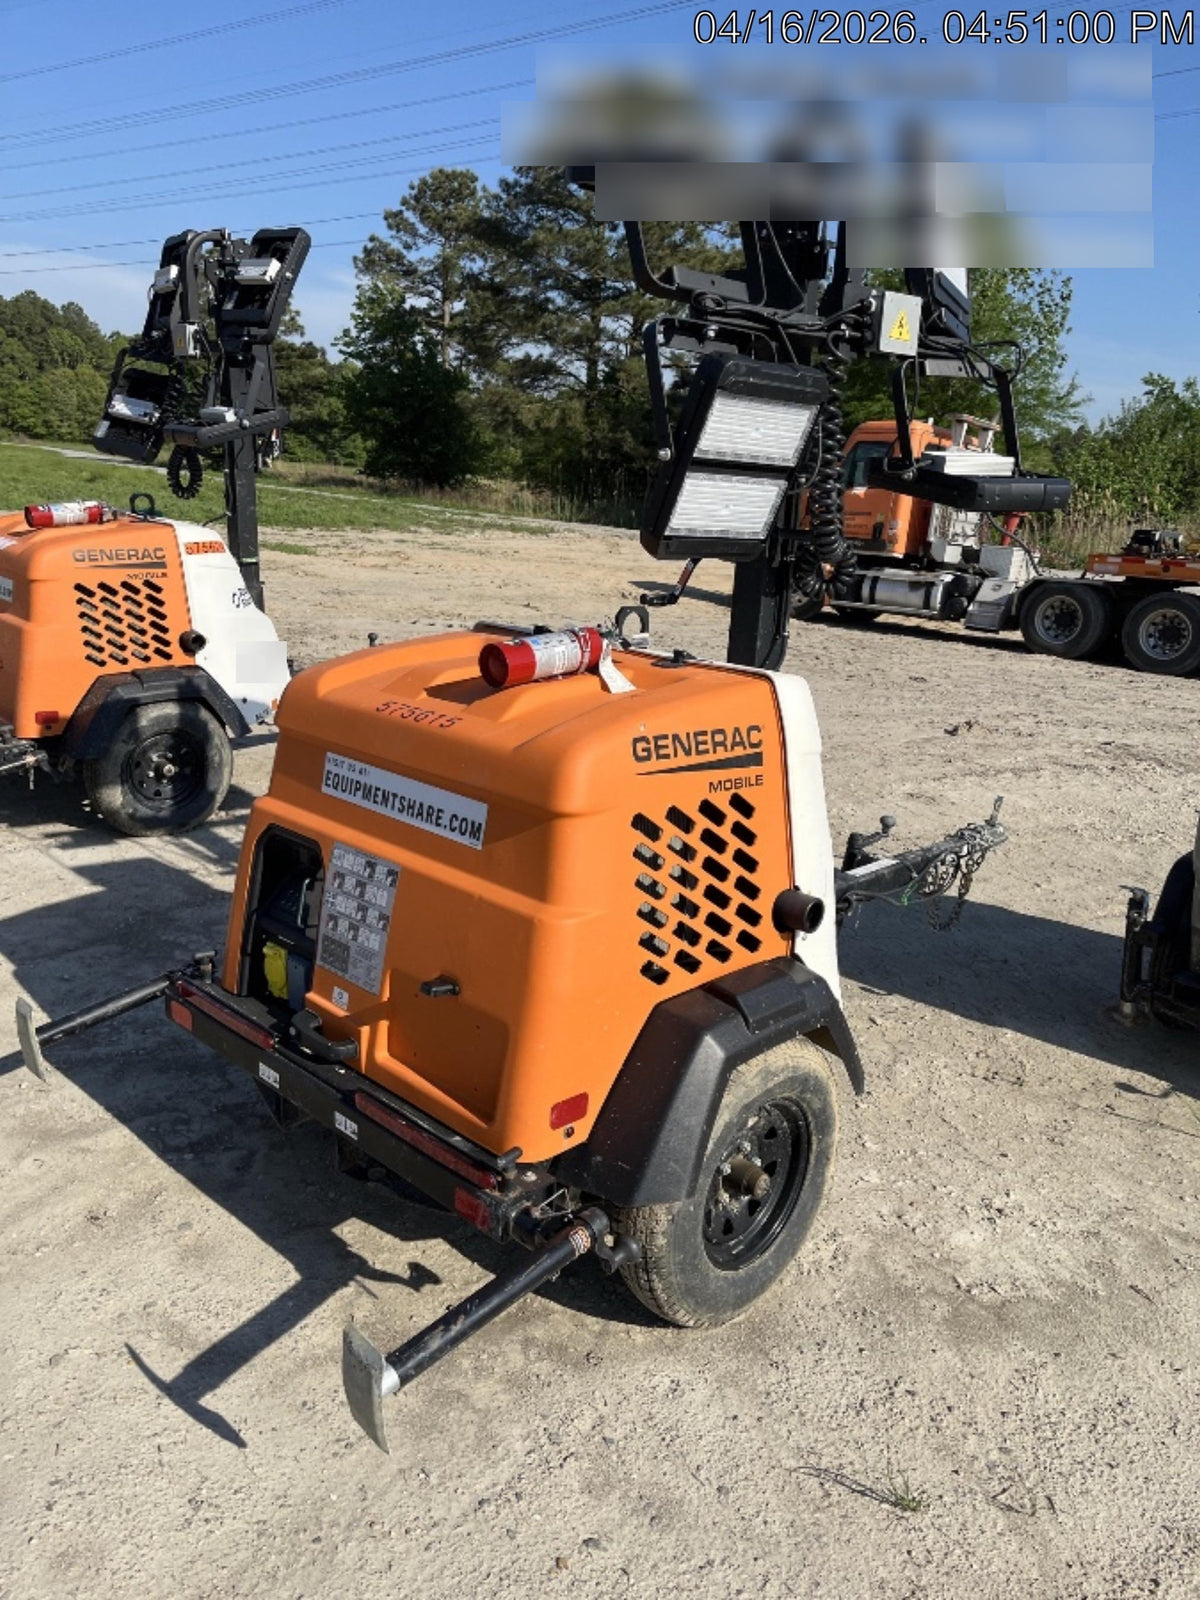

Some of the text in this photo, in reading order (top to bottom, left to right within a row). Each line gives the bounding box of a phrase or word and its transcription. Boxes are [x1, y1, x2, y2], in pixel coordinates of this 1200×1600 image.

[73, 547, 166, 562] GENERAC
[632, 725, 762, 762] GENERAC
[709, 775, 763, 793] MOBILE
[325, 769, 482, 841] EQUIPMENTSHARE.COM
